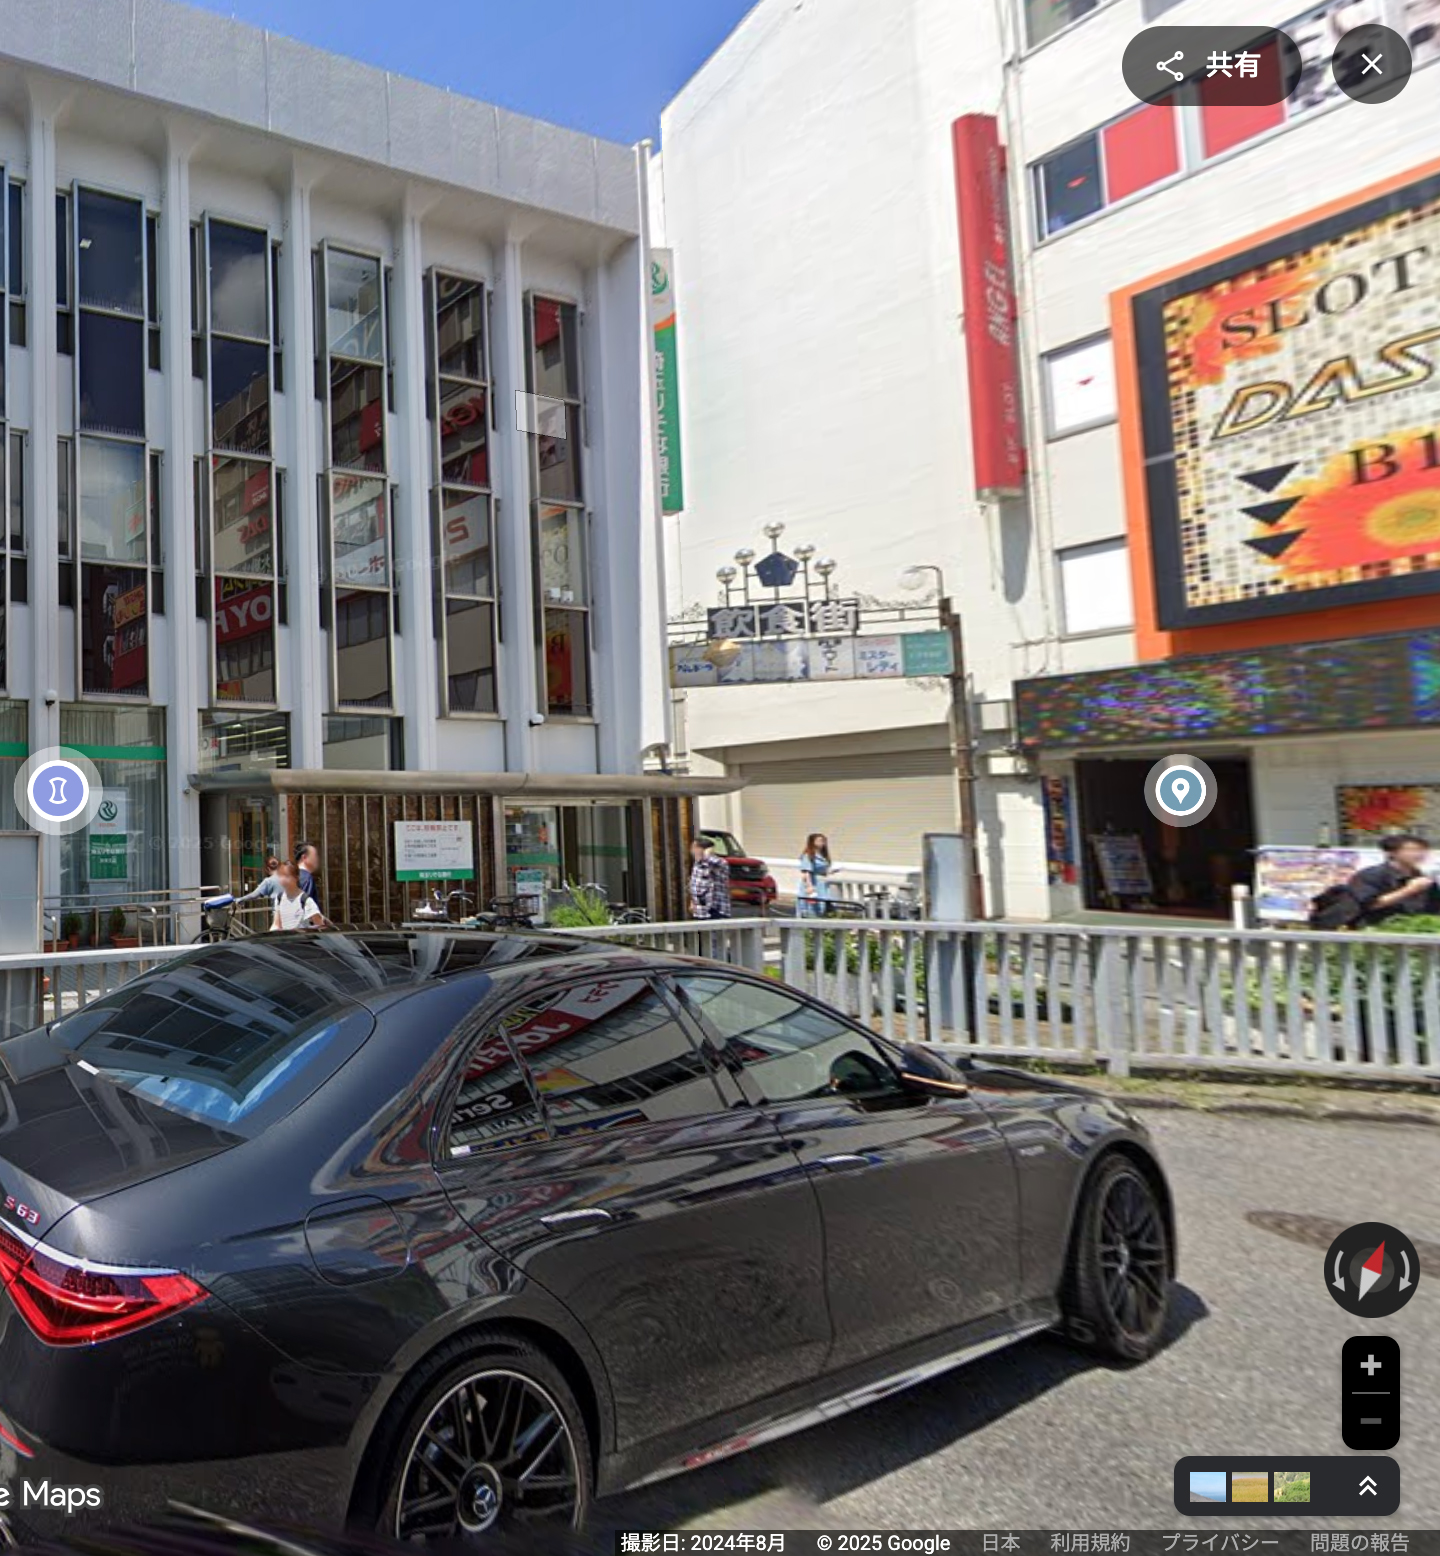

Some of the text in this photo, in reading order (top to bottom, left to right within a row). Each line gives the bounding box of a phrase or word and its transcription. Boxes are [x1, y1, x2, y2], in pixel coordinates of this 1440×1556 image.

[1221, 245, 1429, 348] SLOT
[711, 601, 857, 635] 飲食街
